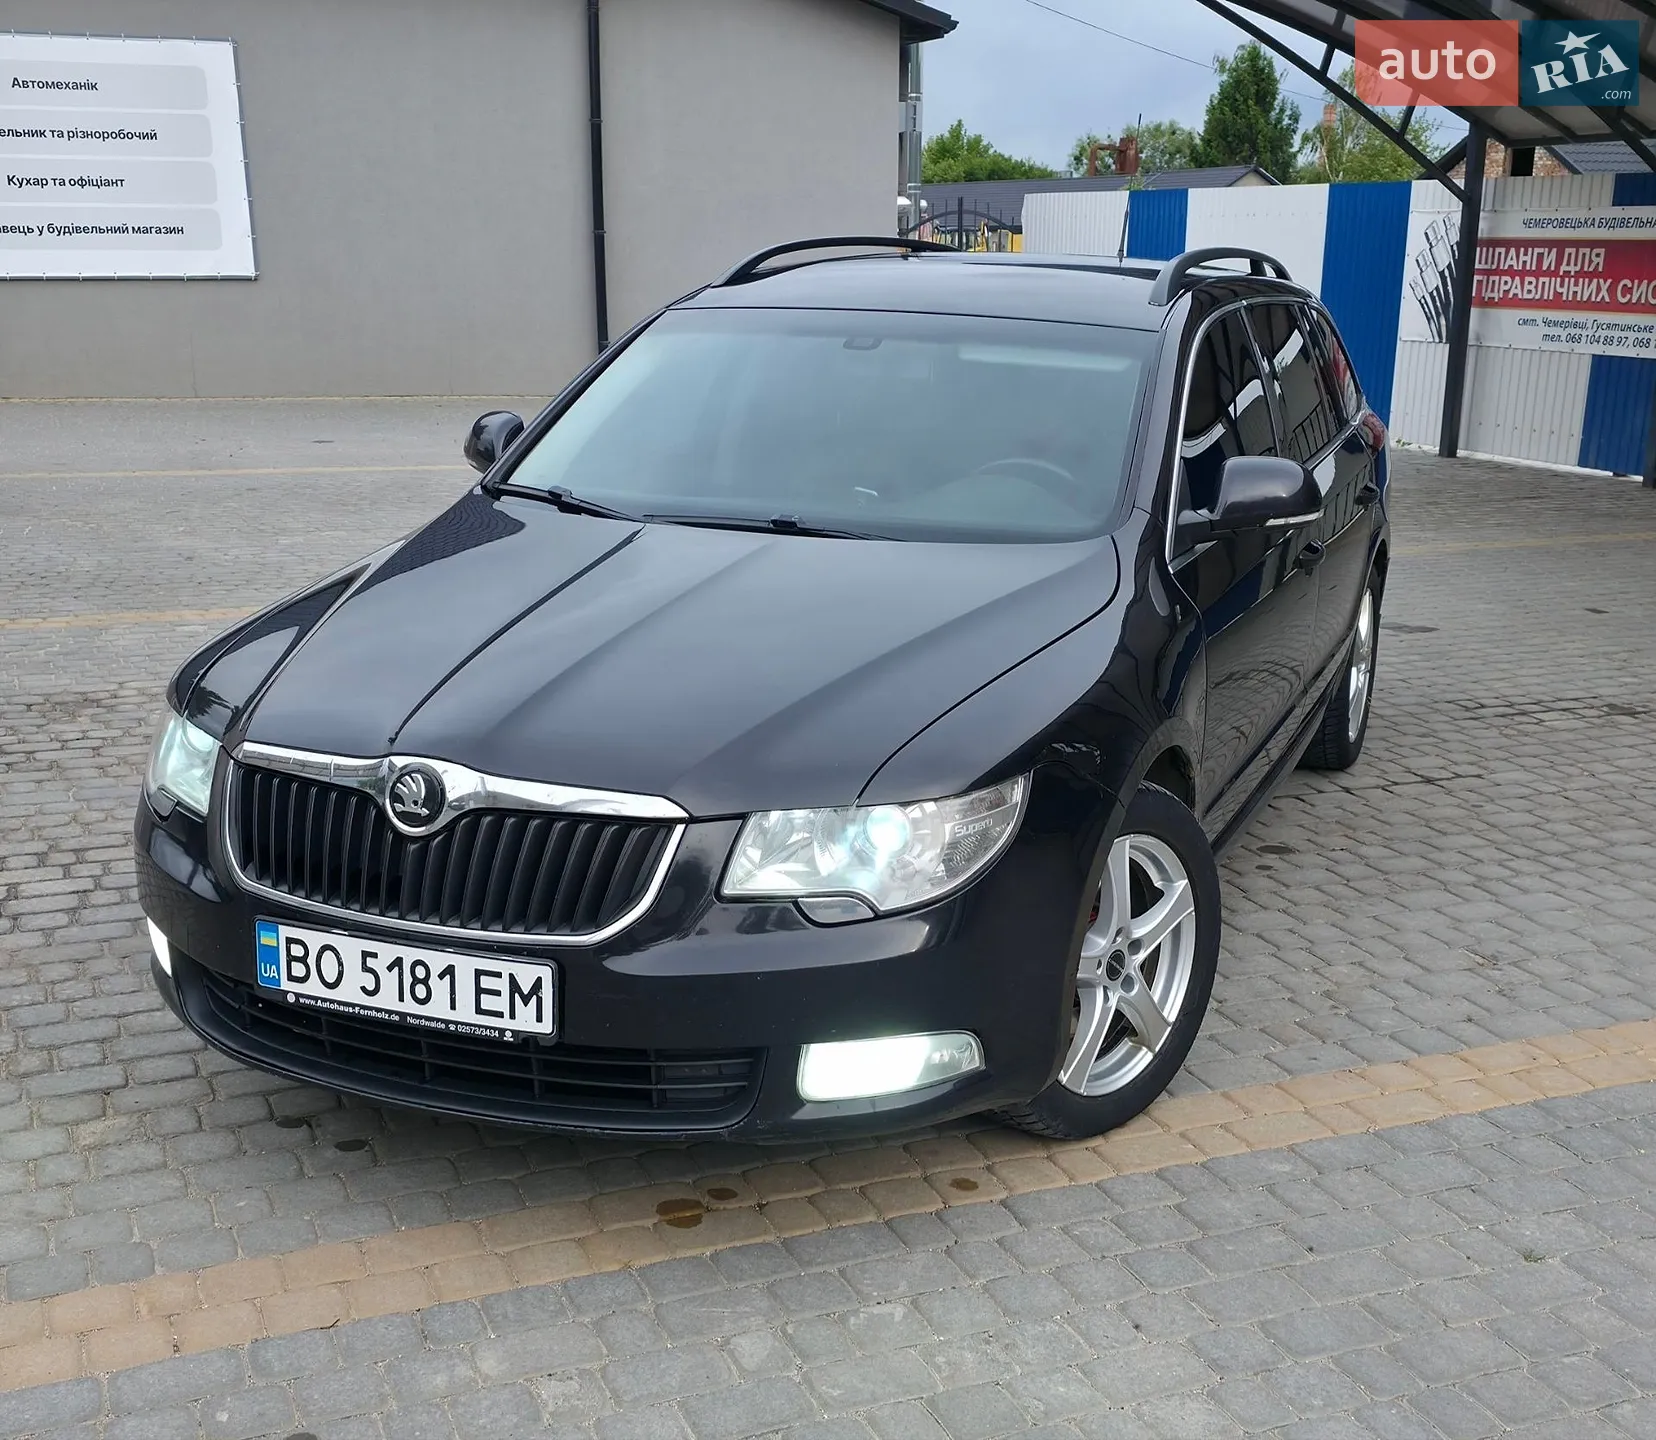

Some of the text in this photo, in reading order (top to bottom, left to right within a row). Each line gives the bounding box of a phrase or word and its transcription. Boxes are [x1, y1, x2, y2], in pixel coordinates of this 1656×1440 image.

[11, 77, 99, 91] Автомеханік
[49, 129, 64, 139] та
[67, 127, 158, 142] різноробочий
[7, 174, 125, 190] Кухар та офіціант
[0, 222, 184, 237] вець у будівельний магазин
[1522, 217, 1596, 231] ЧЕМЕРОВЕЦЬКА
[1475, 247, 1606, 274] ШЛАНГИ ДЛЯ
[1472, 275, 1612, 303] ГІДРАВЛІЧНИХ
[1517, 317, 1655, 333] смт. Чемерівці, Гусятинське
[1541, 333, 1563, 342] тел.
[1565, 333, 1582, 344] 068
[1585, 334, 1601, 345] 104
[1602, 335, 1615, 346] 88
[1632, 337, 1652, 348] 068
[261, 963, 279, 980] UA
[285, 936, 544, 1024] BO 5181 EM
[299, 996, 499, 1038] www.Autohaus-Fernholz.de Nordwalde 02573/3434
